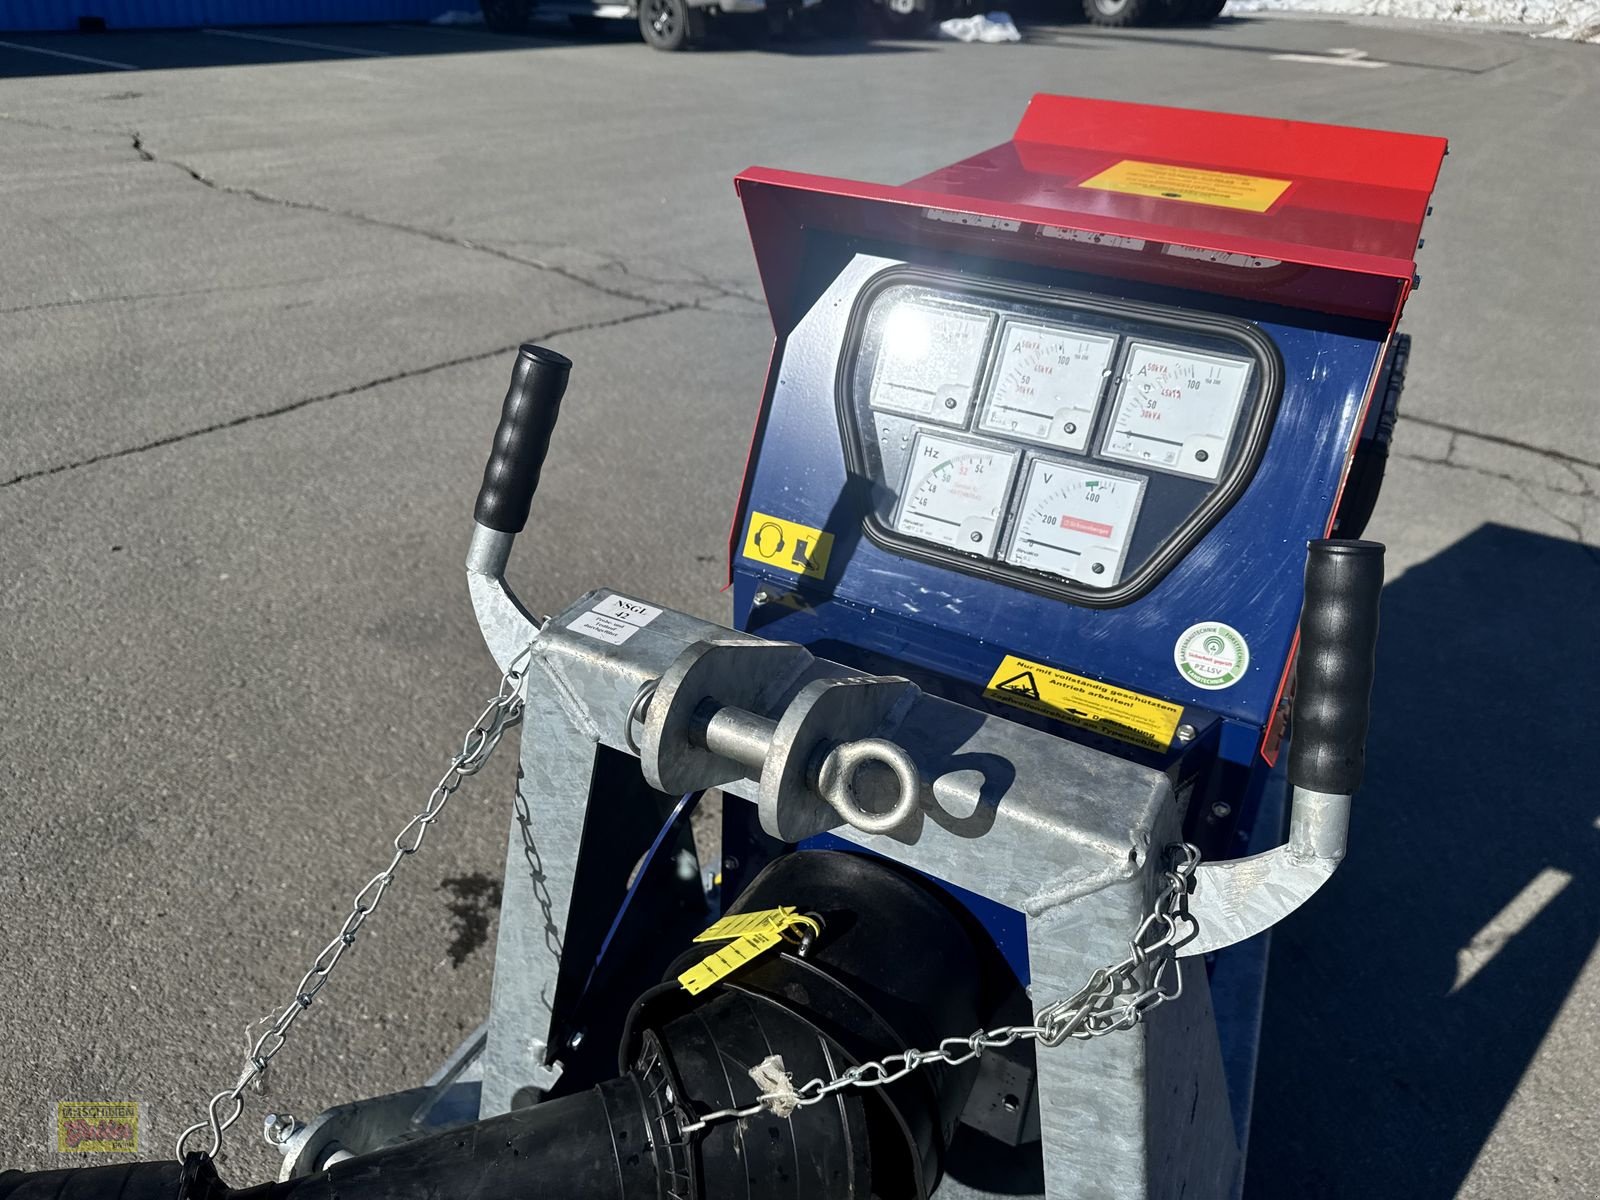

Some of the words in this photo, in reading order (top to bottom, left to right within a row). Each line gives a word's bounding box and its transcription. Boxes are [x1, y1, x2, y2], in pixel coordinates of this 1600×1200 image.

[1013, 342, 1022, 352] A
[1057, 355, 1070, 365] 100
[1138, 365, 1147, 376] A
[1147, 362, 1168, 373] 50kVA
[1021, 375, 1030, 384] 50
[1187, 380, 1200, 390] 100
[1147, 399, 1156, 409] 50
[1140, 409, 1161, 420] 30kVA
[923, 446, 939, 458] Hz
[974, 464, 984, 473] 54
[941, 474, 951, 483] 50
[1043, 473, 1053, 483] V
[928, 483, 937, 493] 48
[918, 496, 928, 506] 46
[1085, 493, 1100, 503] 400
[1042, 514, 1057, 526] 200
[614, 600, 647, 615] NSGL
[1016, 661, 1034, 670] Nur
[1036, 667, 1052, 676] mit
[1055, 673, 1107, 693] vollständig
[1110, 689, 1177, 713] geschütztem
[1049, 679, 1085, 693] Antrieb
[1088, 691, 1134, 708] arbeiten!
[990, 692, 1080, 723] Zapfwellendrehzahl
[1101, 726, 1160, 749] Typenschild
[1092, 714, 1156, 739] Drehrichtung
